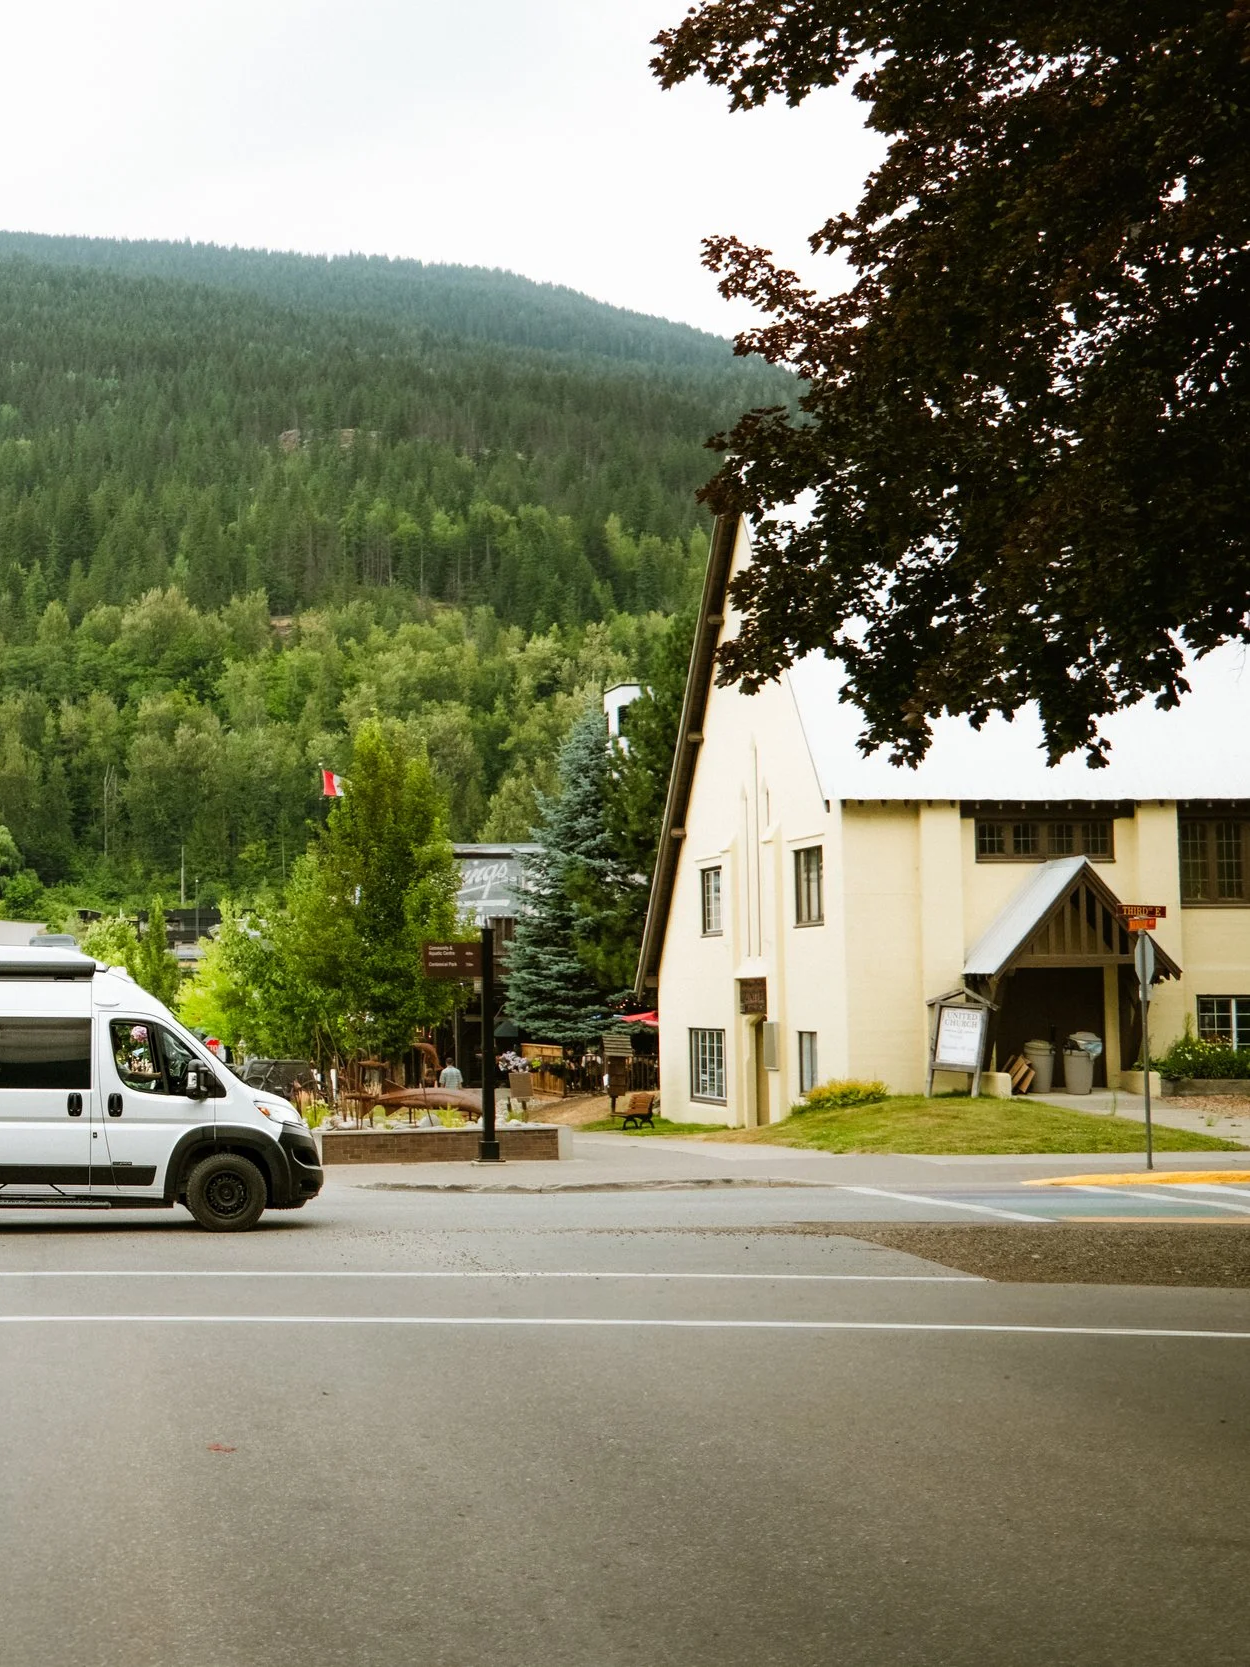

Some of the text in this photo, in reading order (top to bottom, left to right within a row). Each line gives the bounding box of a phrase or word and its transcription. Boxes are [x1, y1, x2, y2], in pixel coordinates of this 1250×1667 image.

[1122, 906, 1148, 916] THIRD
[1155, 907, 1161, 917] E
[947, 1011, 978, 1021] UNITED
[944, 1019, 978, 1029] CHURCH
